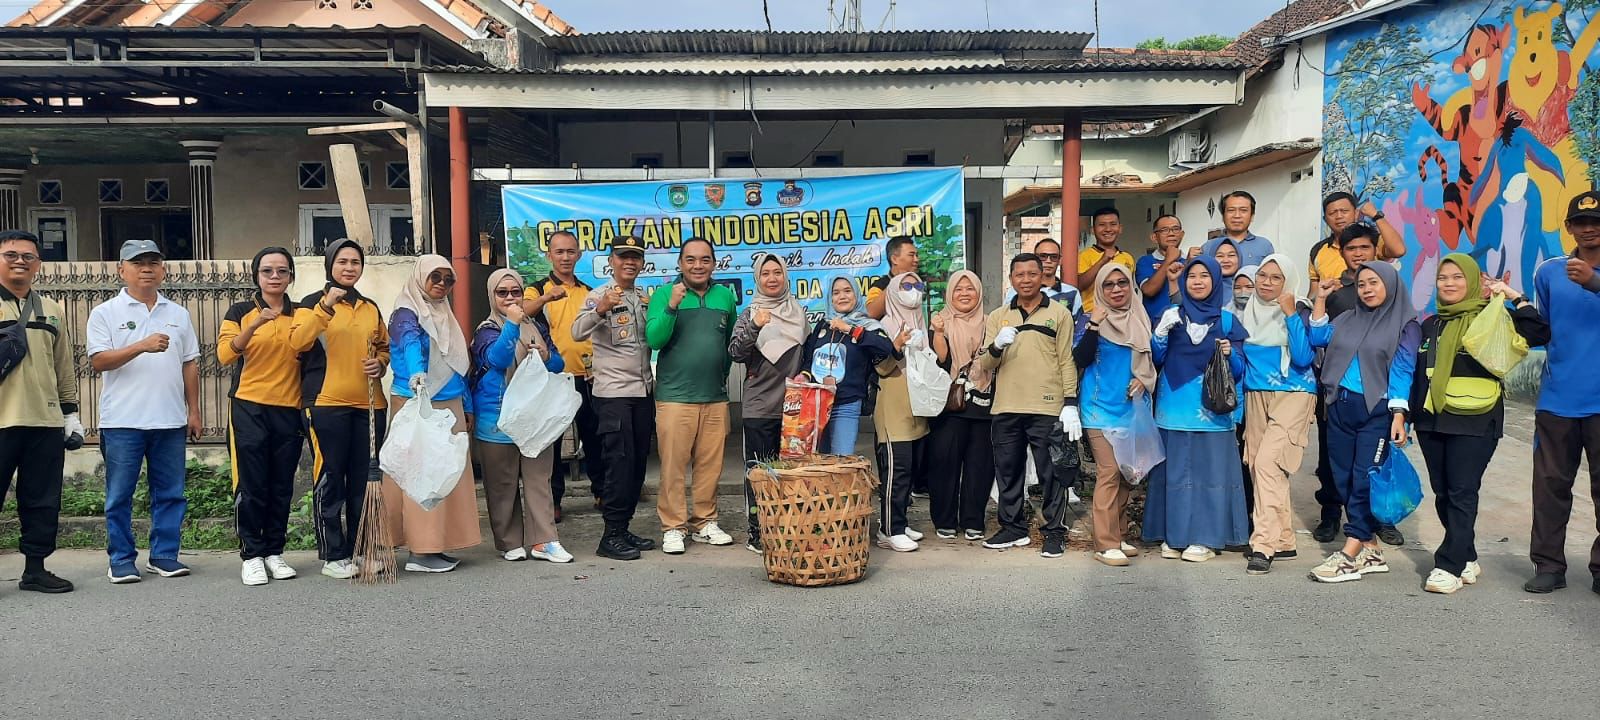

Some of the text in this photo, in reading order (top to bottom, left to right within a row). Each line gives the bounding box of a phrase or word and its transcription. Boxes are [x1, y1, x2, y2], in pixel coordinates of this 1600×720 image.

[692, 208, 853, 247] INDONESIA
[863, 204, 934, 240] ASRI
[821, 247, 874, 266] Indah
